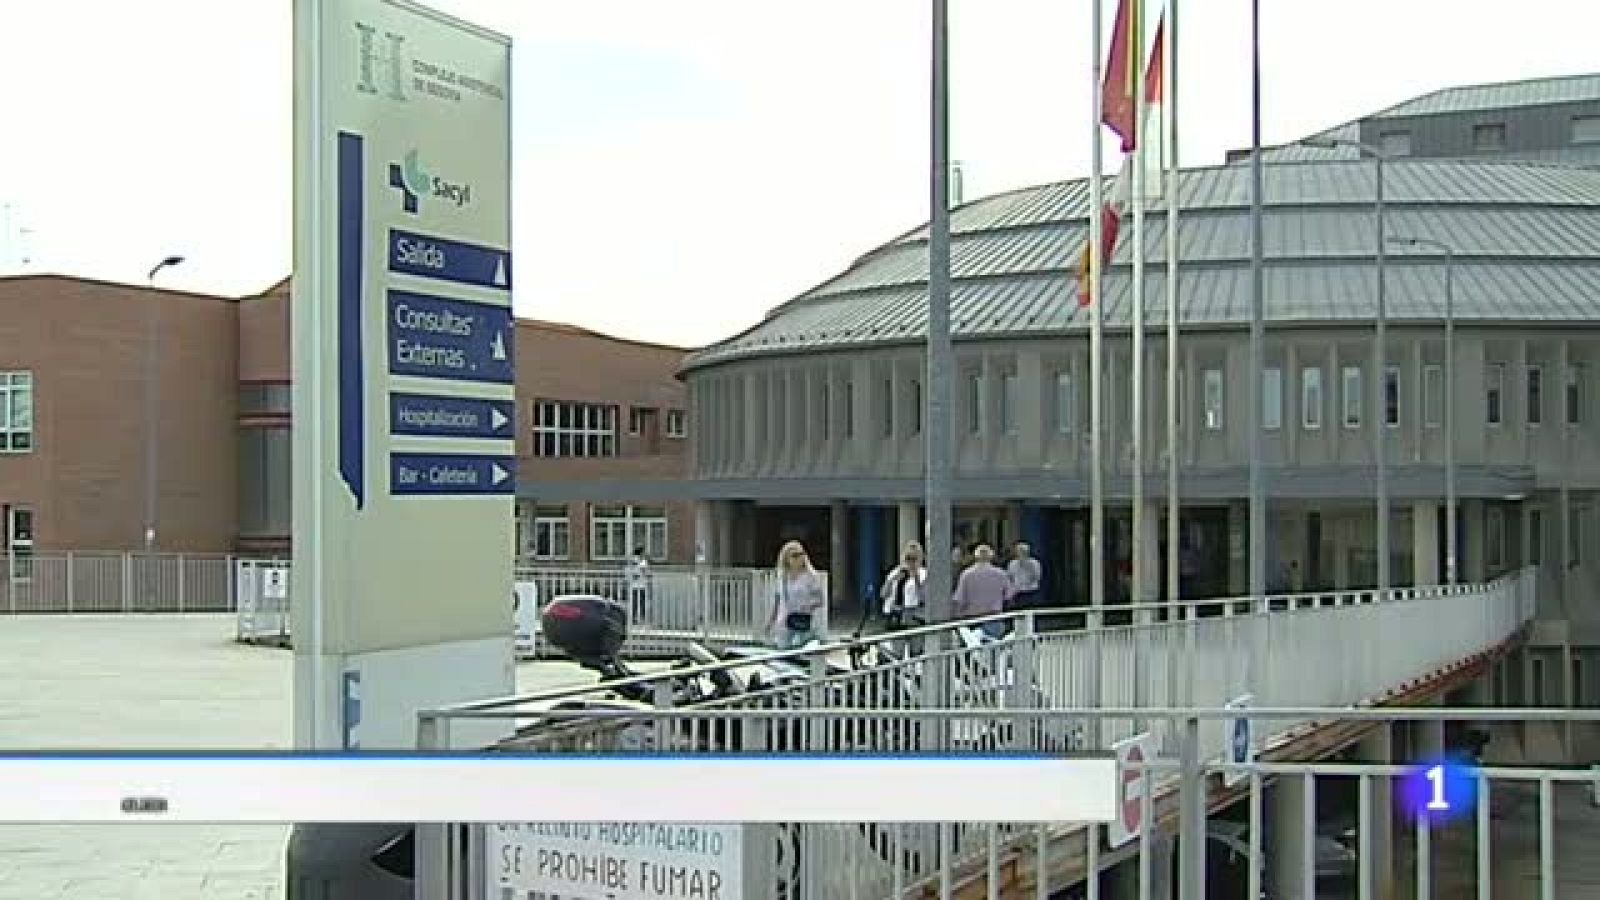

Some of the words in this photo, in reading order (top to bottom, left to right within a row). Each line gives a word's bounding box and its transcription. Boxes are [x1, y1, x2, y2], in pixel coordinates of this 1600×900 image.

[432, 176, 471, 207] Sacyl
[396, 238, 444, 269] Salida
[395, 304, 473, 336] Consultas
[396, 339, 466, 369] Externas
[399, 466, 419, 484] Bar
[500, 845, 521, 875] SE
[538, 848, 628, 891] PROHIBE
[639, 860, 722, 900] FUMAR
